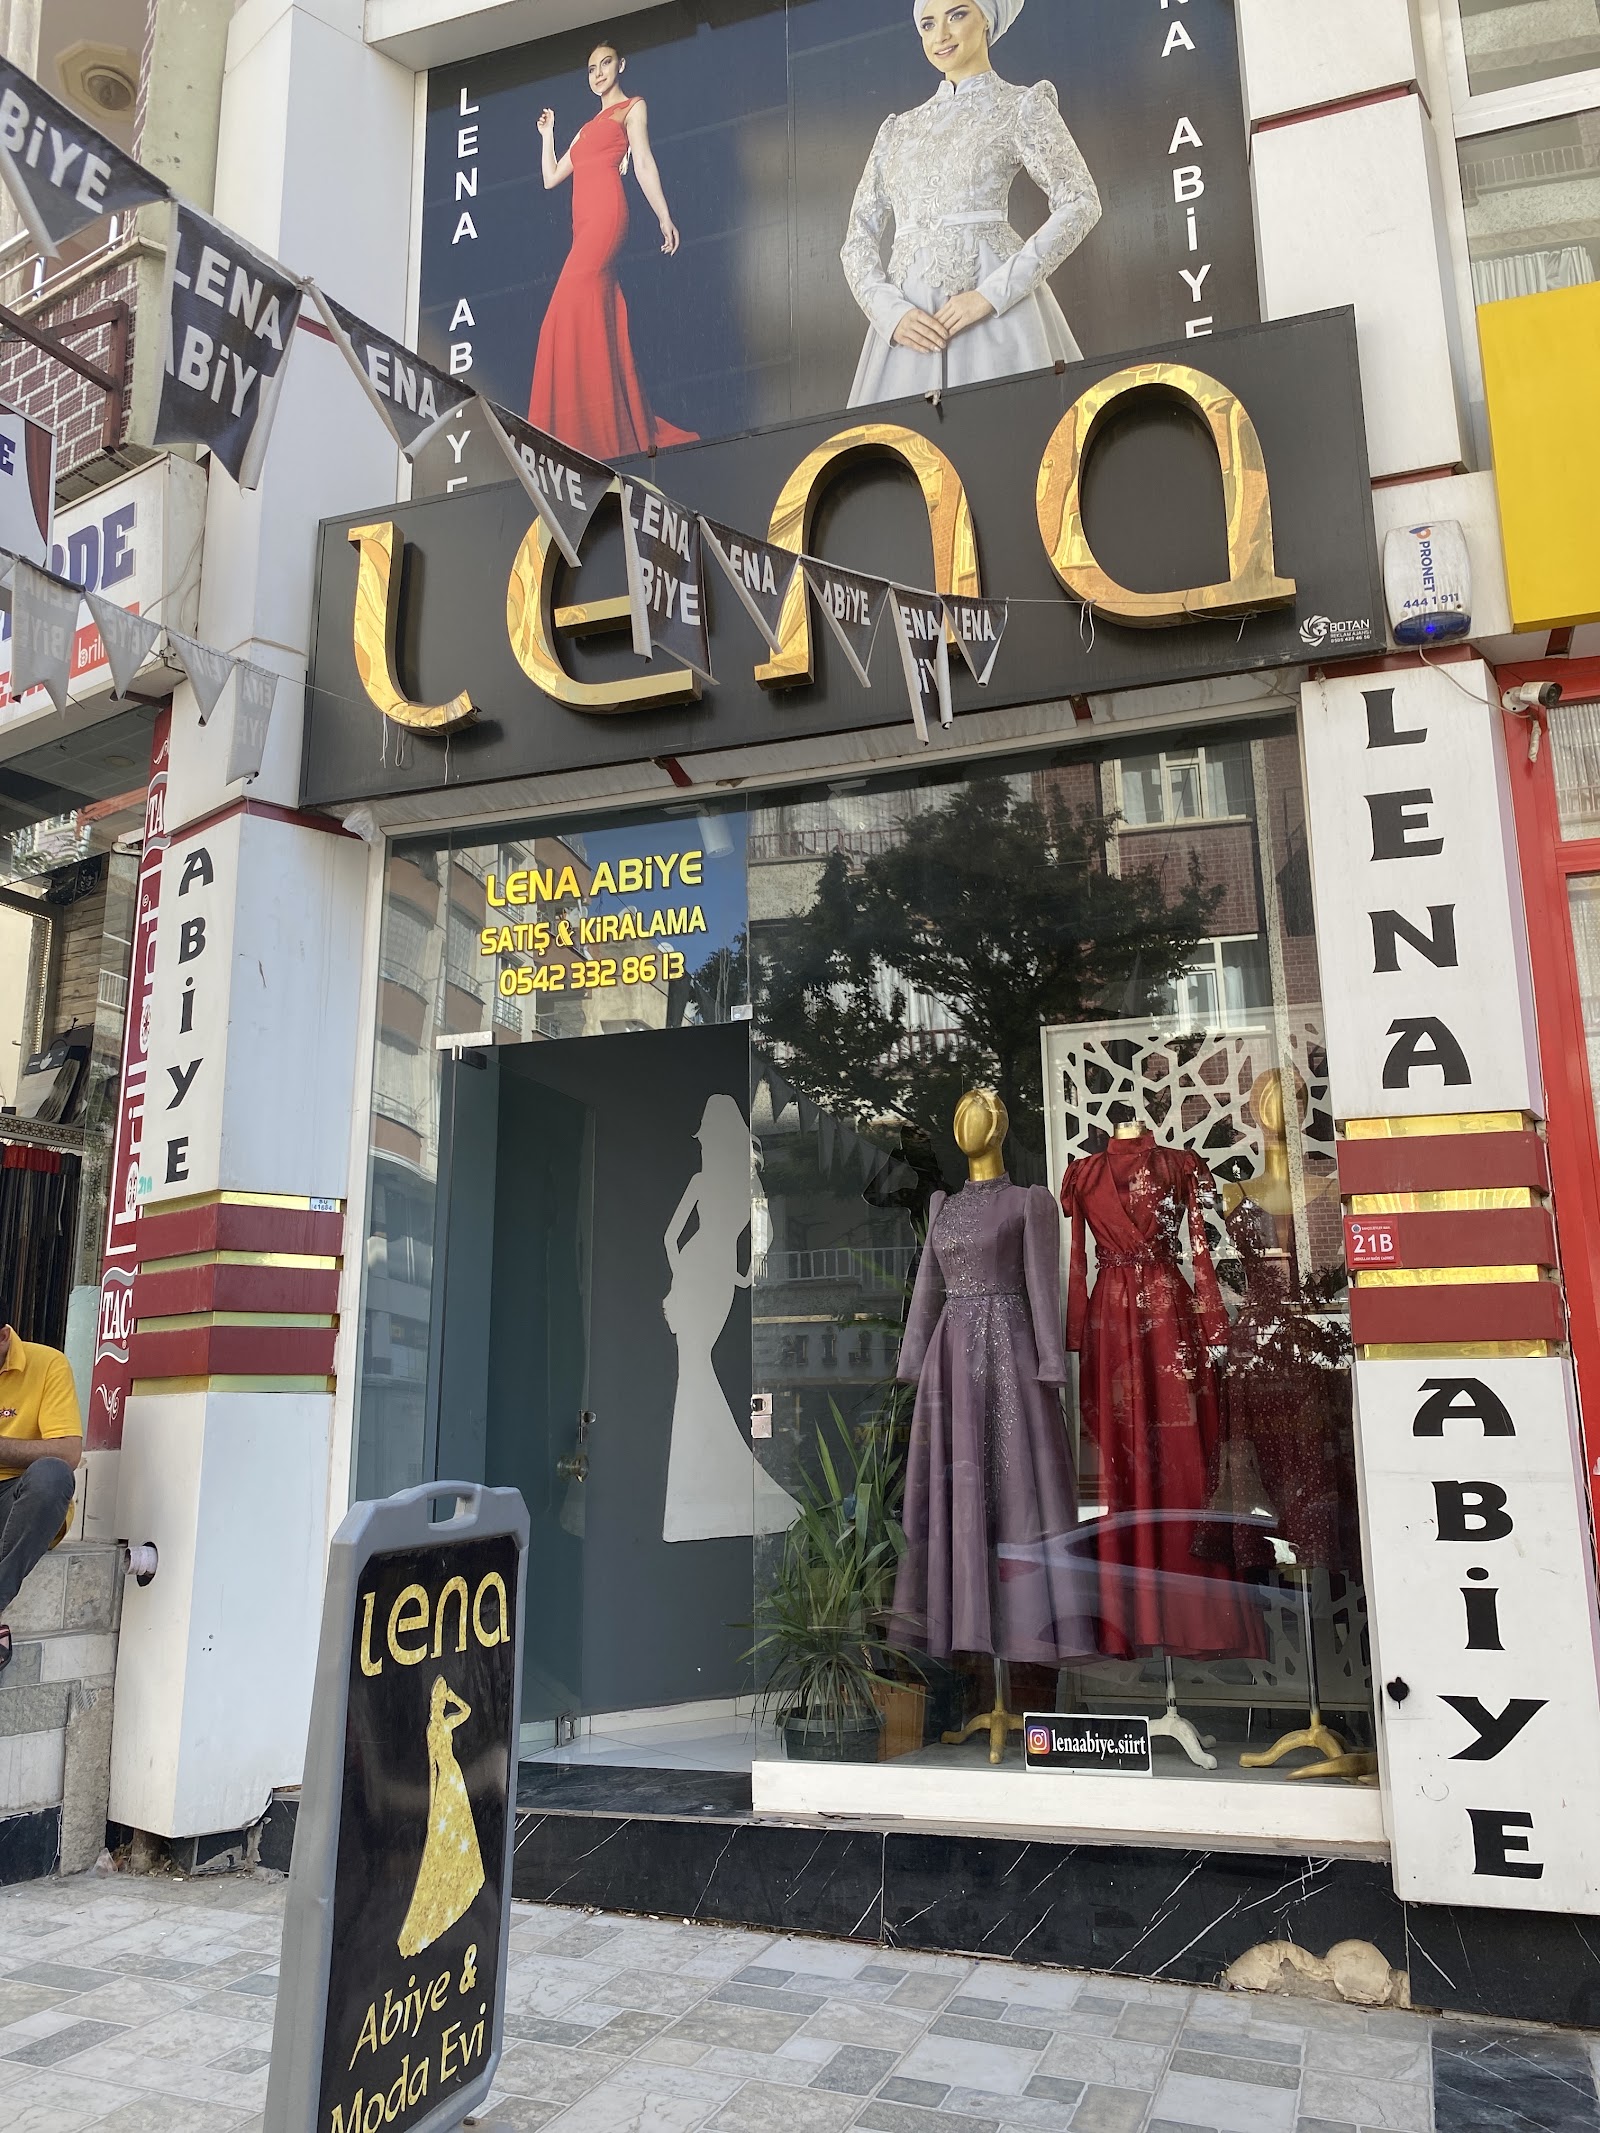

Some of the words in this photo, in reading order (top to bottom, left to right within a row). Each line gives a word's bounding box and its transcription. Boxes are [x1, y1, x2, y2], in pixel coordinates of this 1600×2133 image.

[451, 87, 480, 246] LENA
[343, 330, 440, 422] ENA
[1419, 541, 1435, 592] PRONET
[1330, 619, 1370, 632] BOTAN
[1403, 597, 1428, 609] 444
[1441, 593, 1460, 603] 911
[486, 865, 582, 908] LENA
[1360, 687, 1473, 1090] LENA
[480, 922, 550, 956] SATIŞ
[554, 919, 575, 947] &
[499, 964, 566, 997] 0542
[569, 958, 617, 990] 332
[621, 954, 657, 984] 86
[662, 951, 686, 982] 13
[1352, 1233, 1394, 1254] 21B
[101, 1289, 133, 1341] TAC
[360, 1571, 511, 1678] lena
[1051, 1728, 1147, 1761] lenaabiye.siirt
[348, 1970, 452, 2072] Abiye
[458, 1943, 478, 1995] &
[439, 2002, 487, 2084] Evi
